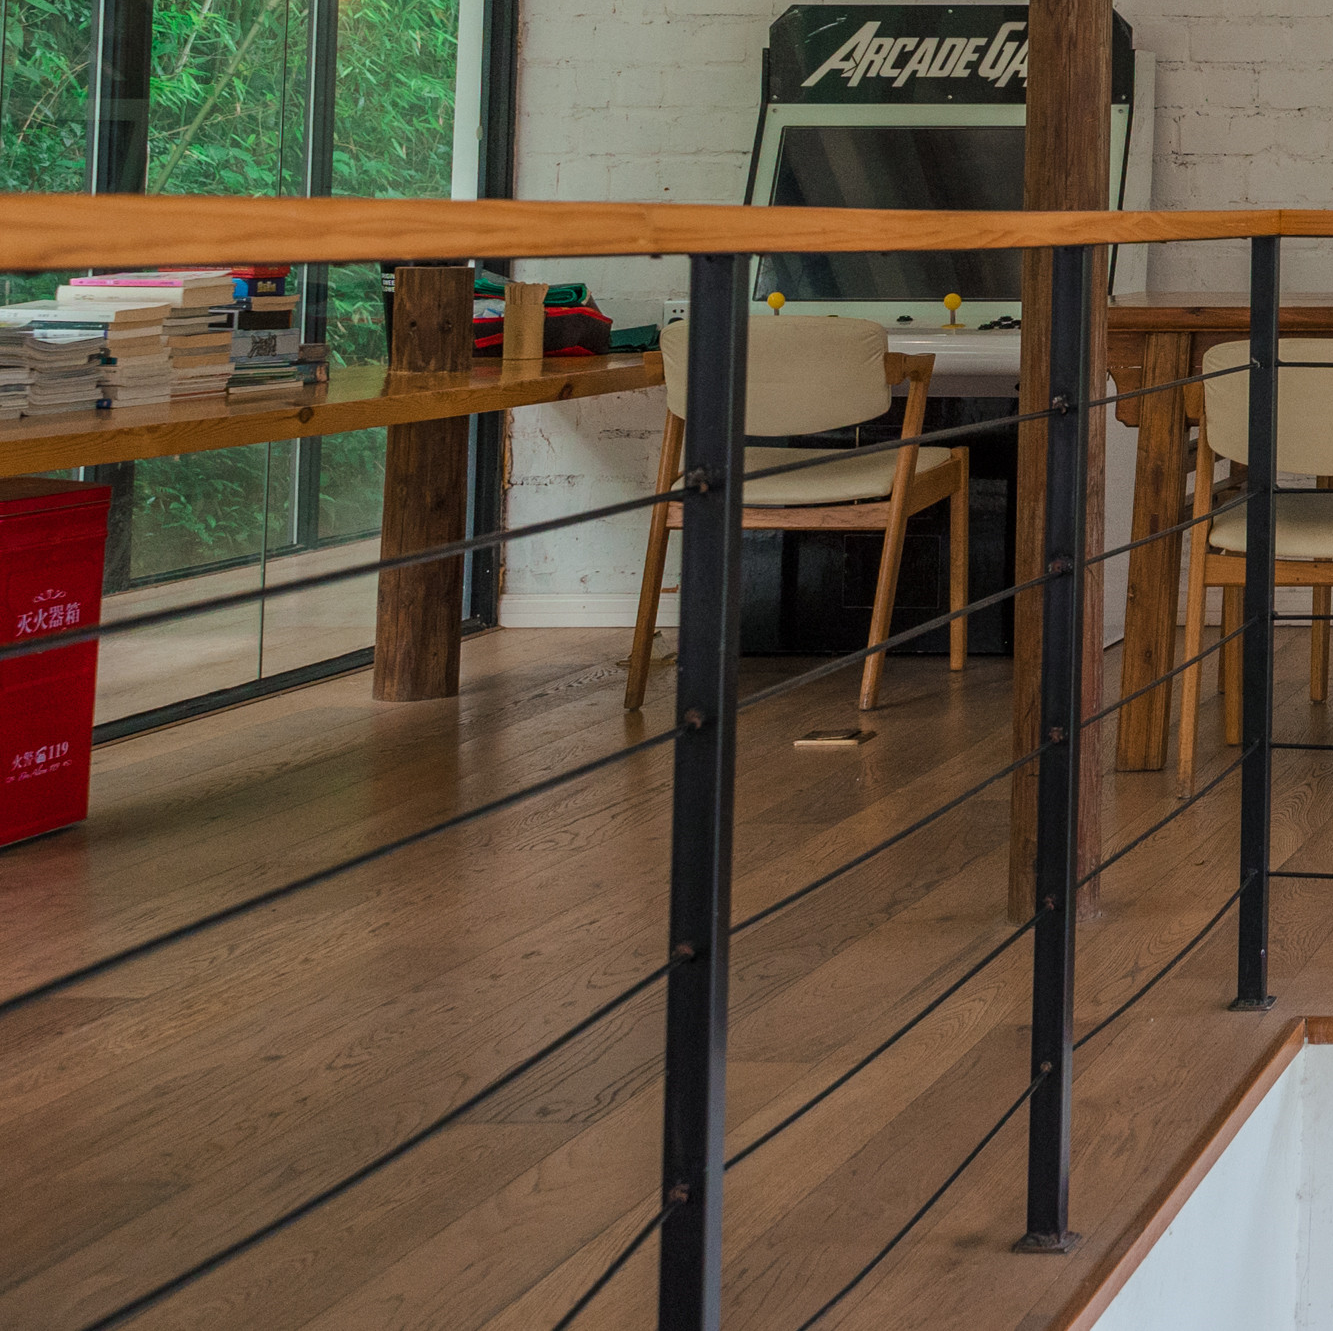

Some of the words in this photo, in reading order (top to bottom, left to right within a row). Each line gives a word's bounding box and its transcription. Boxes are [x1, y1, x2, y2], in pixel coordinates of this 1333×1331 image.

[800, 21, 988, 87] ARCADE
[977, 21, 1029, 87] GA
[16, 602, 81, 636] 灭火器箱
[48, 741, 69, 759] 119
